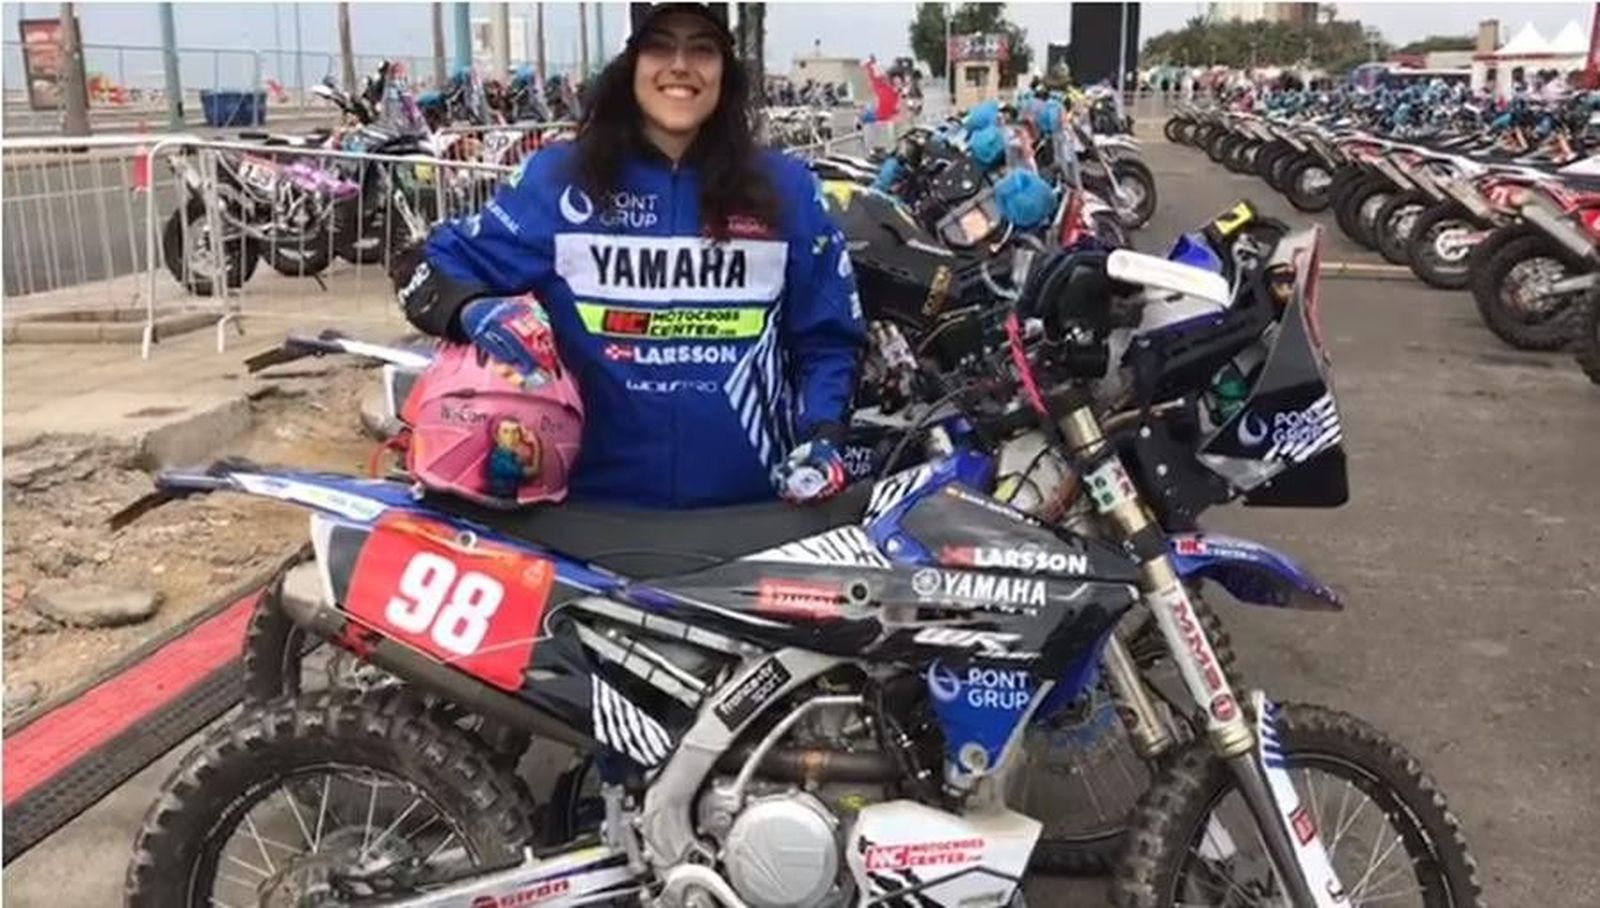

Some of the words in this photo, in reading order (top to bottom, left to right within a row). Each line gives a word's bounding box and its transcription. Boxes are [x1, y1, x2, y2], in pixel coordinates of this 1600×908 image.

[603, 191, 658, 210] ONT
[590, 245, 746, 288] YAMAHA
[634, 346, 736, 364] LARSSON
[974, 548, 1087, 574] LARSSON
[945, 573, 1046, 606] YAMAHA
[384, 551, 505, 655] 98
[968, 667, 1029, 688] PONT
[968, 689, 1030, 709] GRUP
